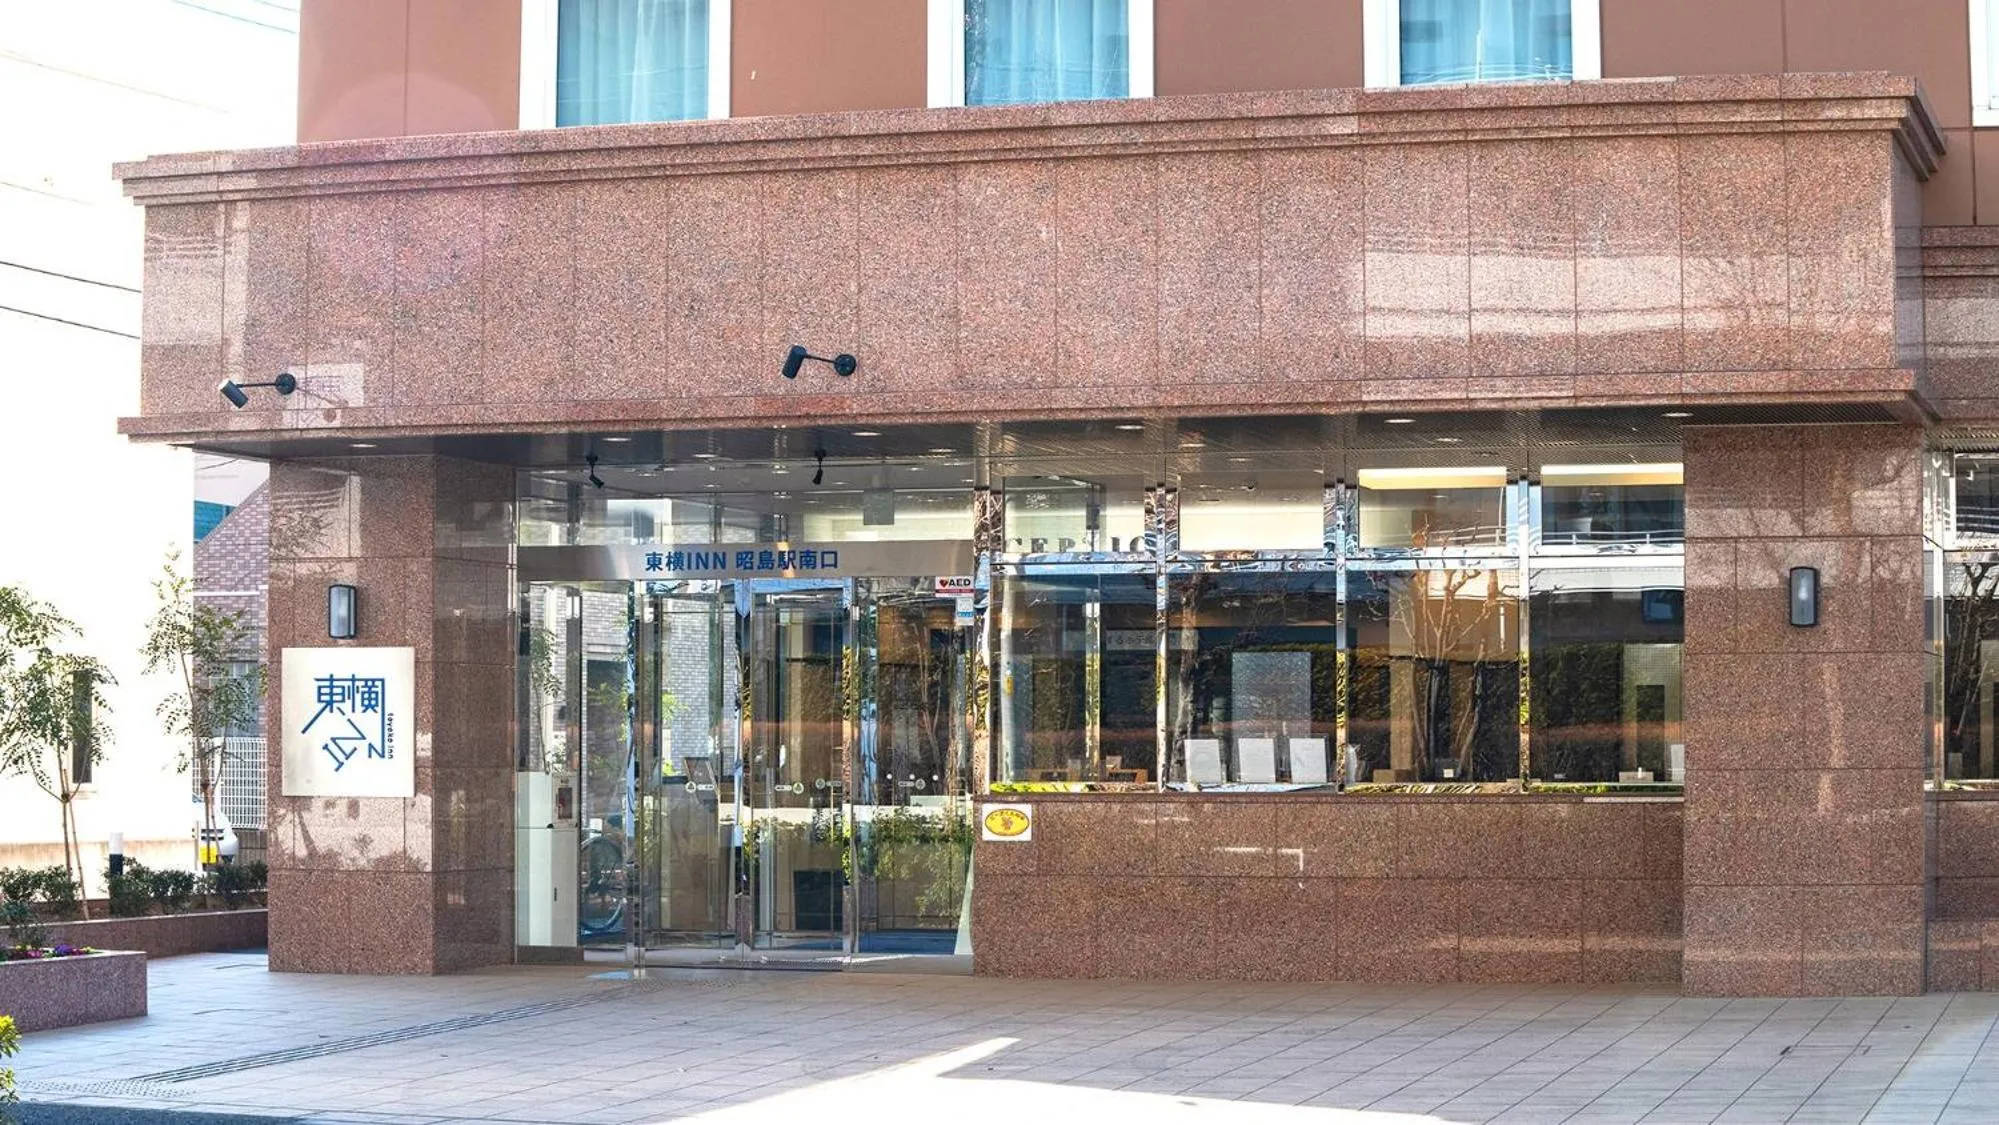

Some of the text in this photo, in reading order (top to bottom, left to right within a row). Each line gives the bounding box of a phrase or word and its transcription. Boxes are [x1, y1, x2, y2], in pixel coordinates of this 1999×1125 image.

[645, 549, 838, 571] 東横INN 昭島駅南口
[949, 579, 971, 587] AED
[386, 712, 395, 759] toyoko inn
